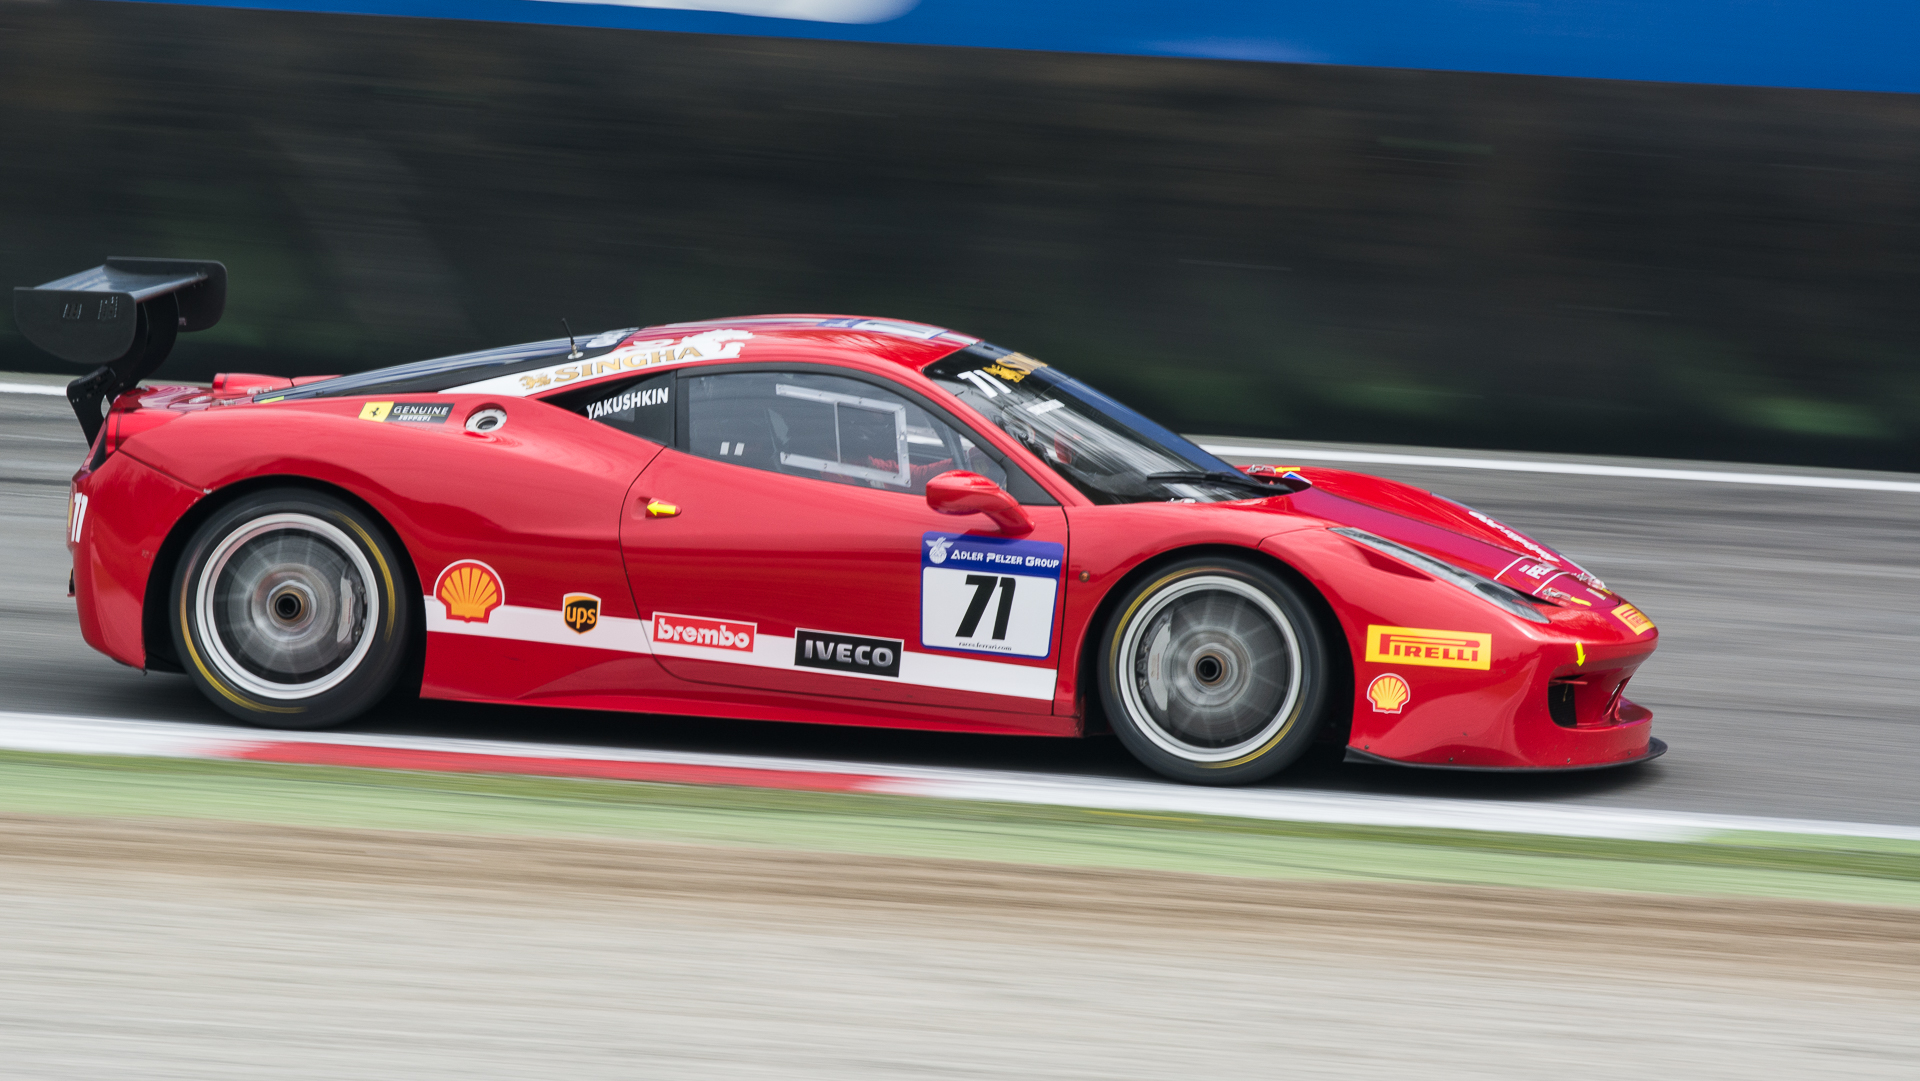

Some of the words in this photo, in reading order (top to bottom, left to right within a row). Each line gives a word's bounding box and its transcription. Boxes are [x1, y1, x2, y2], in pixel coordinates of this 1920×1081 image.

[554, 347, 703, 383] SINGHA
[957, 369, 1012, 399] 71
[393, 405, 449, 416] GENUINE
[586, 387, 669, 420] YAKUSHKIN
[950, 549, 984, 562] ADLER
[986, 552, 1023, 565] PELZER
[1025, 556, 1060, 569] GROUP
[566, 606, 597, 630] ups
[955, 574, 1017, 638] 71
[657, 618, 750, 649] brembo
[1378, 633, 1481, 662] PIRELLI
[804, 639, 894, 668] IVECO
